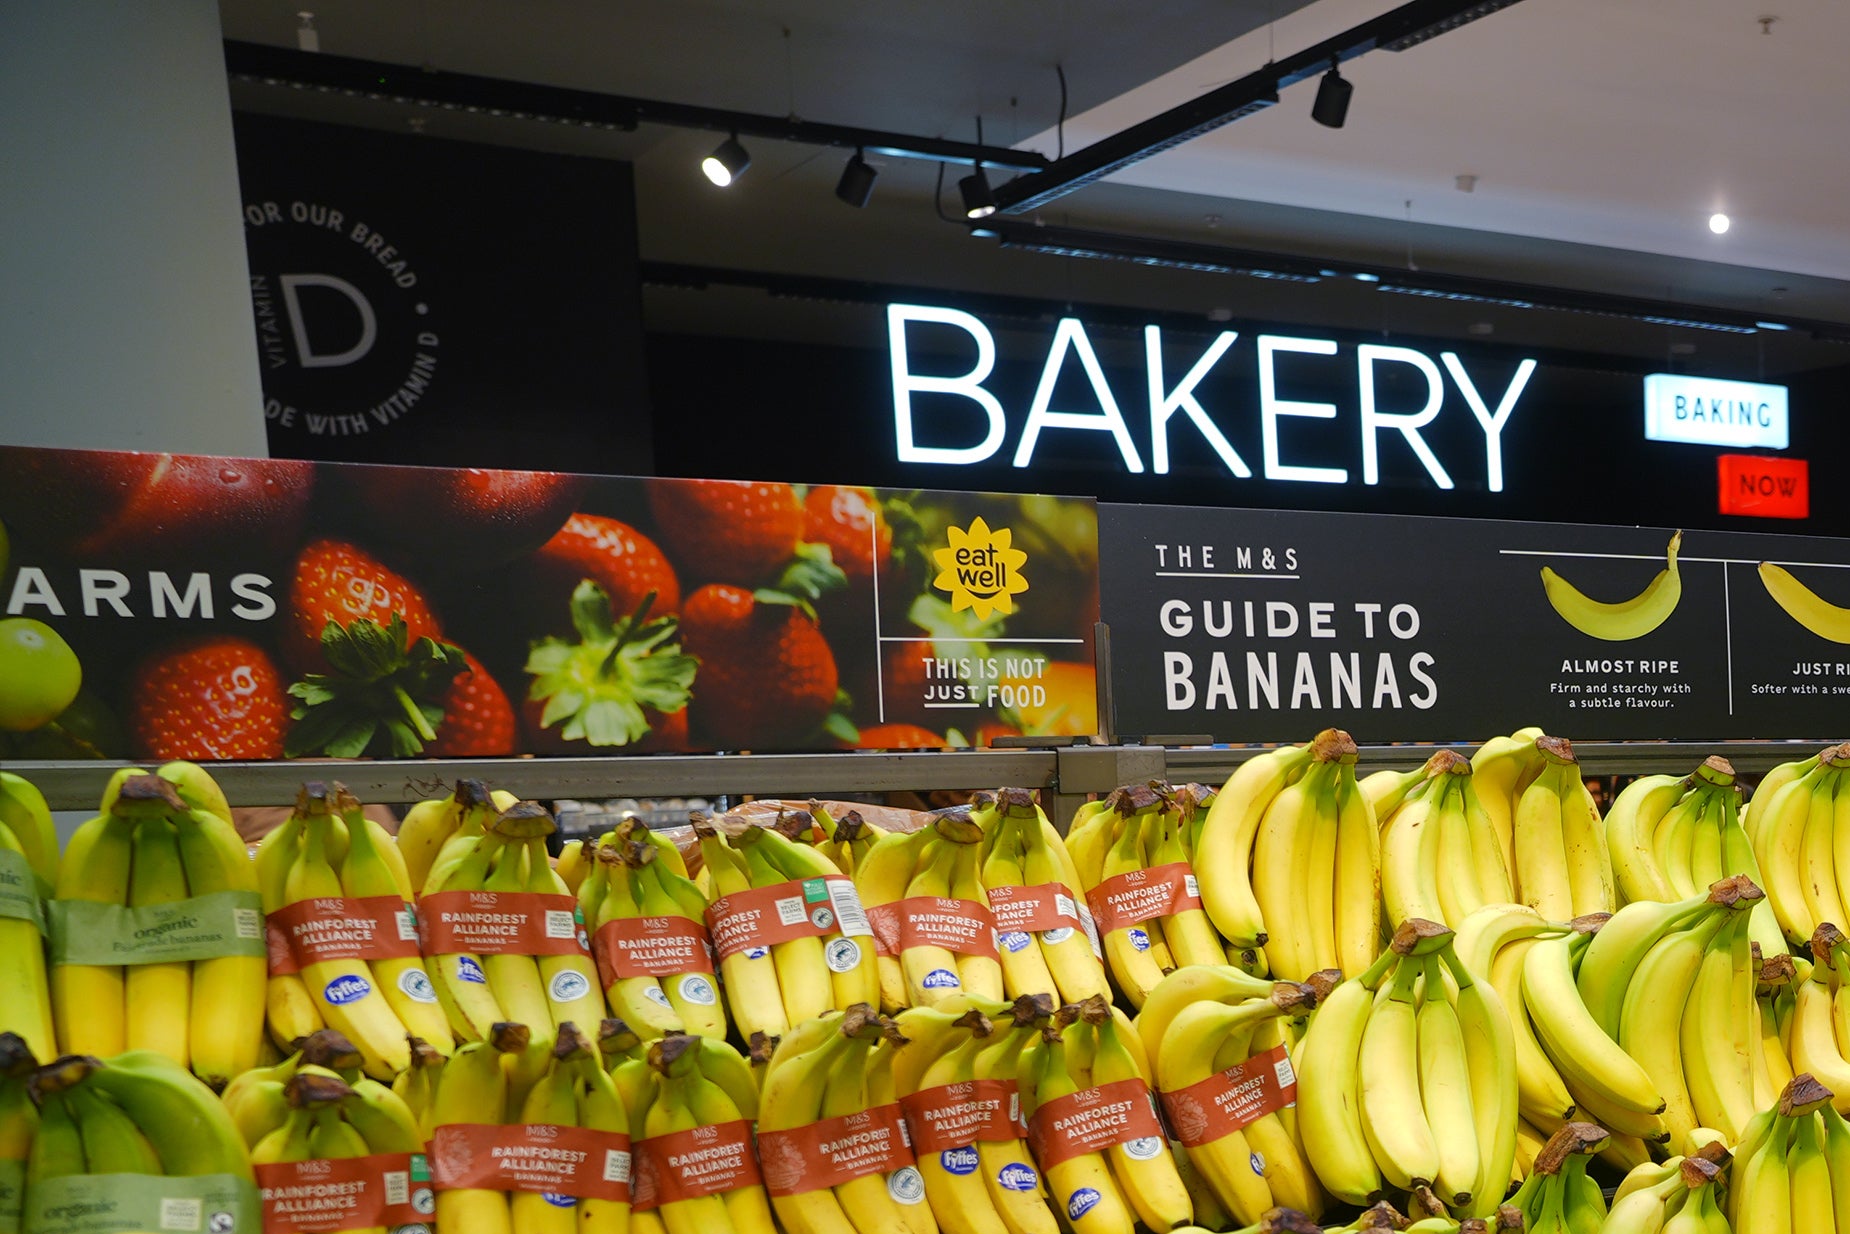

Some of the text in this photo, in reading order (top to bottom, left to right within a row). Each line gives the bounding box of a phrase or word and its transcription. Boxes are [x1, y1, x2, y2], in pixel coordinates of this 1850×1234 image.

[243, 201, 418, 289] OR OUR BREAD
[279, 273, 378, 369] D
[305, 412, 368, 436] WITH
[371, 354, 437, 426] VITAMIN
[418, 331, 439, 347] D
[886, 302, 1538, 493] BAKERY
[1675, 394, 1771, 428] BAKING
[1739, 473, 1797, 499] NOW
[956, 544, 998, 567] eat
[1155, 545, 1299, 571] THE M&S
[956, 562, 1007, 591] well
[1159, 600, 1421, 640] GUIDE TO
[922, 657, 1045, 679] THIS IS NOT
[1562, 659, 1679, 674] ALMOST RIPE
[1793, 662, 1831, 676] JUST
[1164, 651, 1438, 711] BANANAS
[1550, 682, 1691, 697] Firm and starchy with
[1751, 684, 1787, 695] Softer
[1792, 684, 1817, 695] with
[1822, 686, 1828, 695] a
[924, 685, 1046, 708] JUST FOOD
[1569, 696, 1675, 709] a subtle flavour.
[1126, 870, 1146, 882] M&S
[989, 887, 1012, 898] M&S
[1107, 882, 1172, 905] RAINFOREST
[936, 898, 961, 909] M&S
[1116, 893, 1170, 912] ALLIANCE
[441, 913, 527, 925] RAINFOREST
[642, 918, 668, 929] M&S
[909, 914, 984, 929] RAINFOREST
[293, 919, 377, 937] RAINFOREST
[452, 924, 519, 936] ALLIANCE
[917, 923, 976, 937] ALLIANCE
[302, 930, 372, 945] ALLIANCE
[618, 936, 697, 951] RAINFOREST
[927, 933, 965, 943] BANANAS
[629, 947, 692, 960] ALLIANCE
[1225, 1066, 1243, 1080] M&S
[946, 1083, 973, 1096] M&S
[1073, 1090, 1100, 1103] M&S
[1214, 1075, 1266, 1107] RAINFOREST
[924, 1100, 1000, 1121] RAINFOREST
[1224, 1090, 1263, 1114] ALLIANCE
[844, 1113, 870, 1127] M&S
[935, 1112, 992, 1130] ALLIANCE
[1053, 1101, 1133, 1130] RAINFOREST
[1067, 1114, 1128, 1139] ALLIANCE
[492, 1147, 587, 1162] RAINFOREST
[668, 1143, 745, 1167] RAINFOREST
[500, 1159, 575, 1175] ALLIANCE
[682, 1156, 742, 1177] ALLIANCE
[274, 1195, 357, 1212] ALLIANCE
